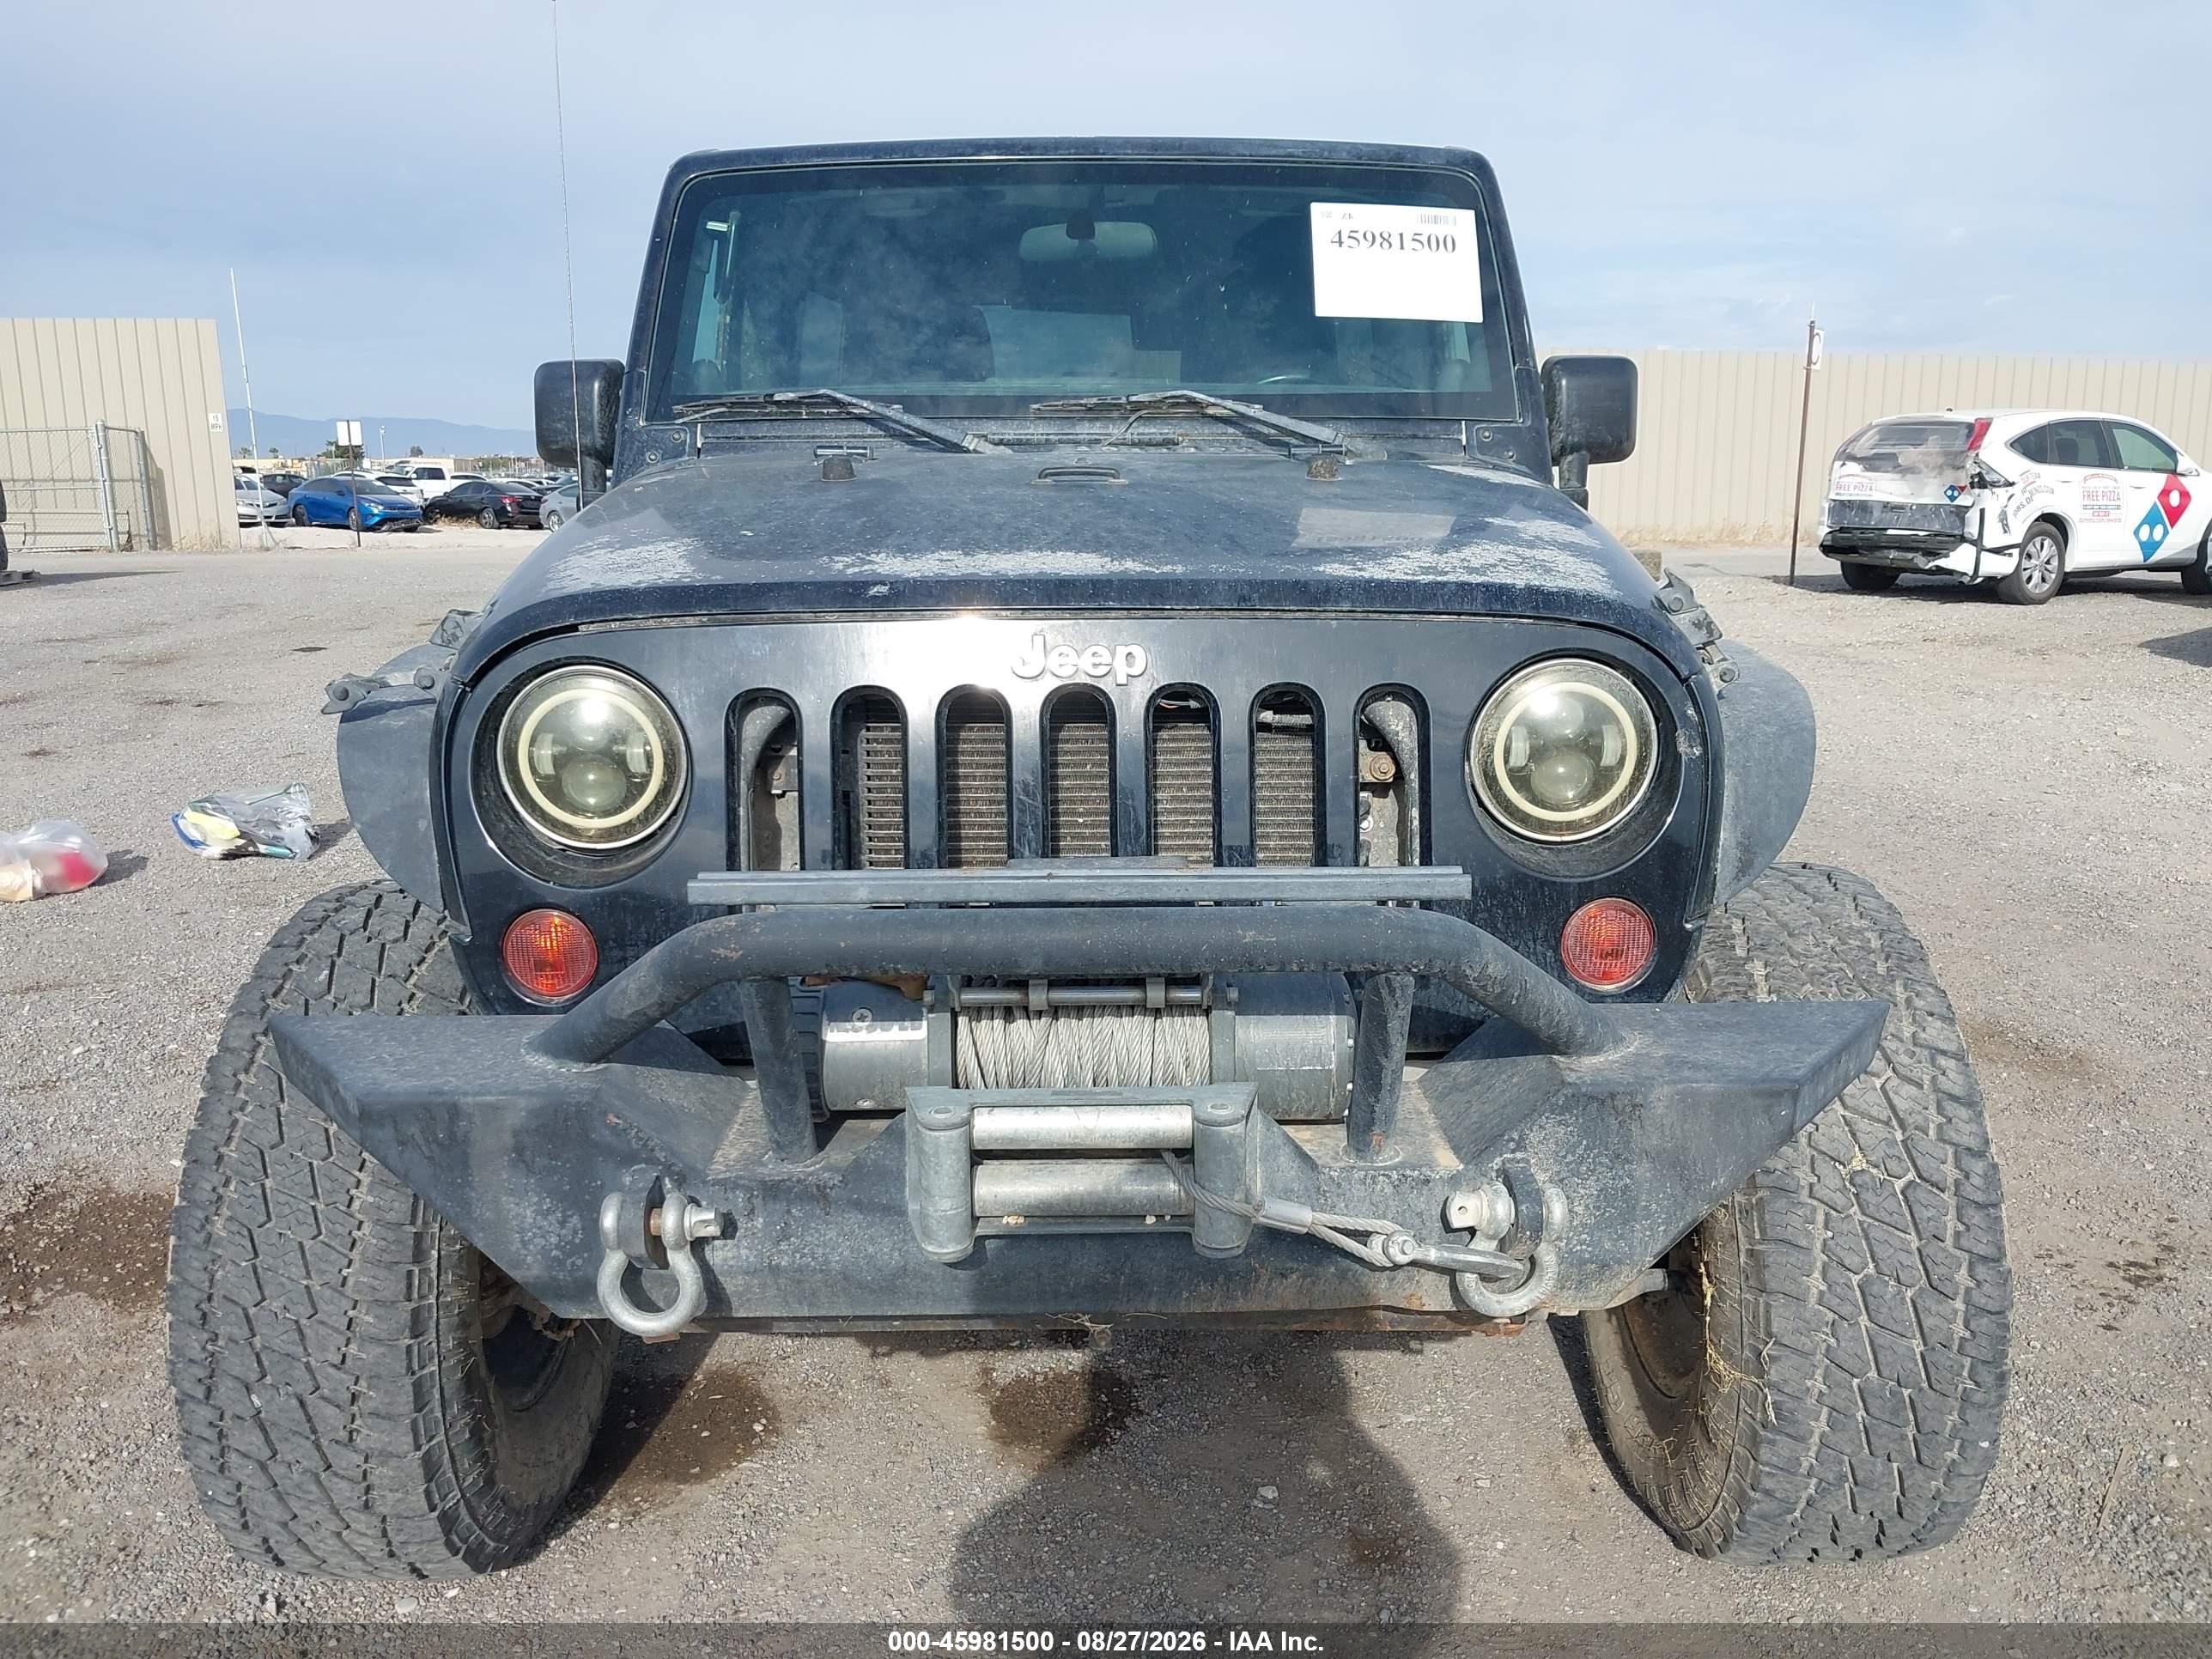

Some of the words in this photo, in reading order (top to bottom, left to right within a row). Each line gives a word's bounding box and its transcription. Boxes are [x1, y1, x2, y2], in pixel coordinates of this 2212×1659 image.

[1330, 228, 1457, 254] 45981500
[1835, 483, 1851, 491] FREE
[2082, 489, 2100, 502] FREE
[2101, 489, 2121, 502] PIZZA
[1010, 634, 1149, 687] Jeep
